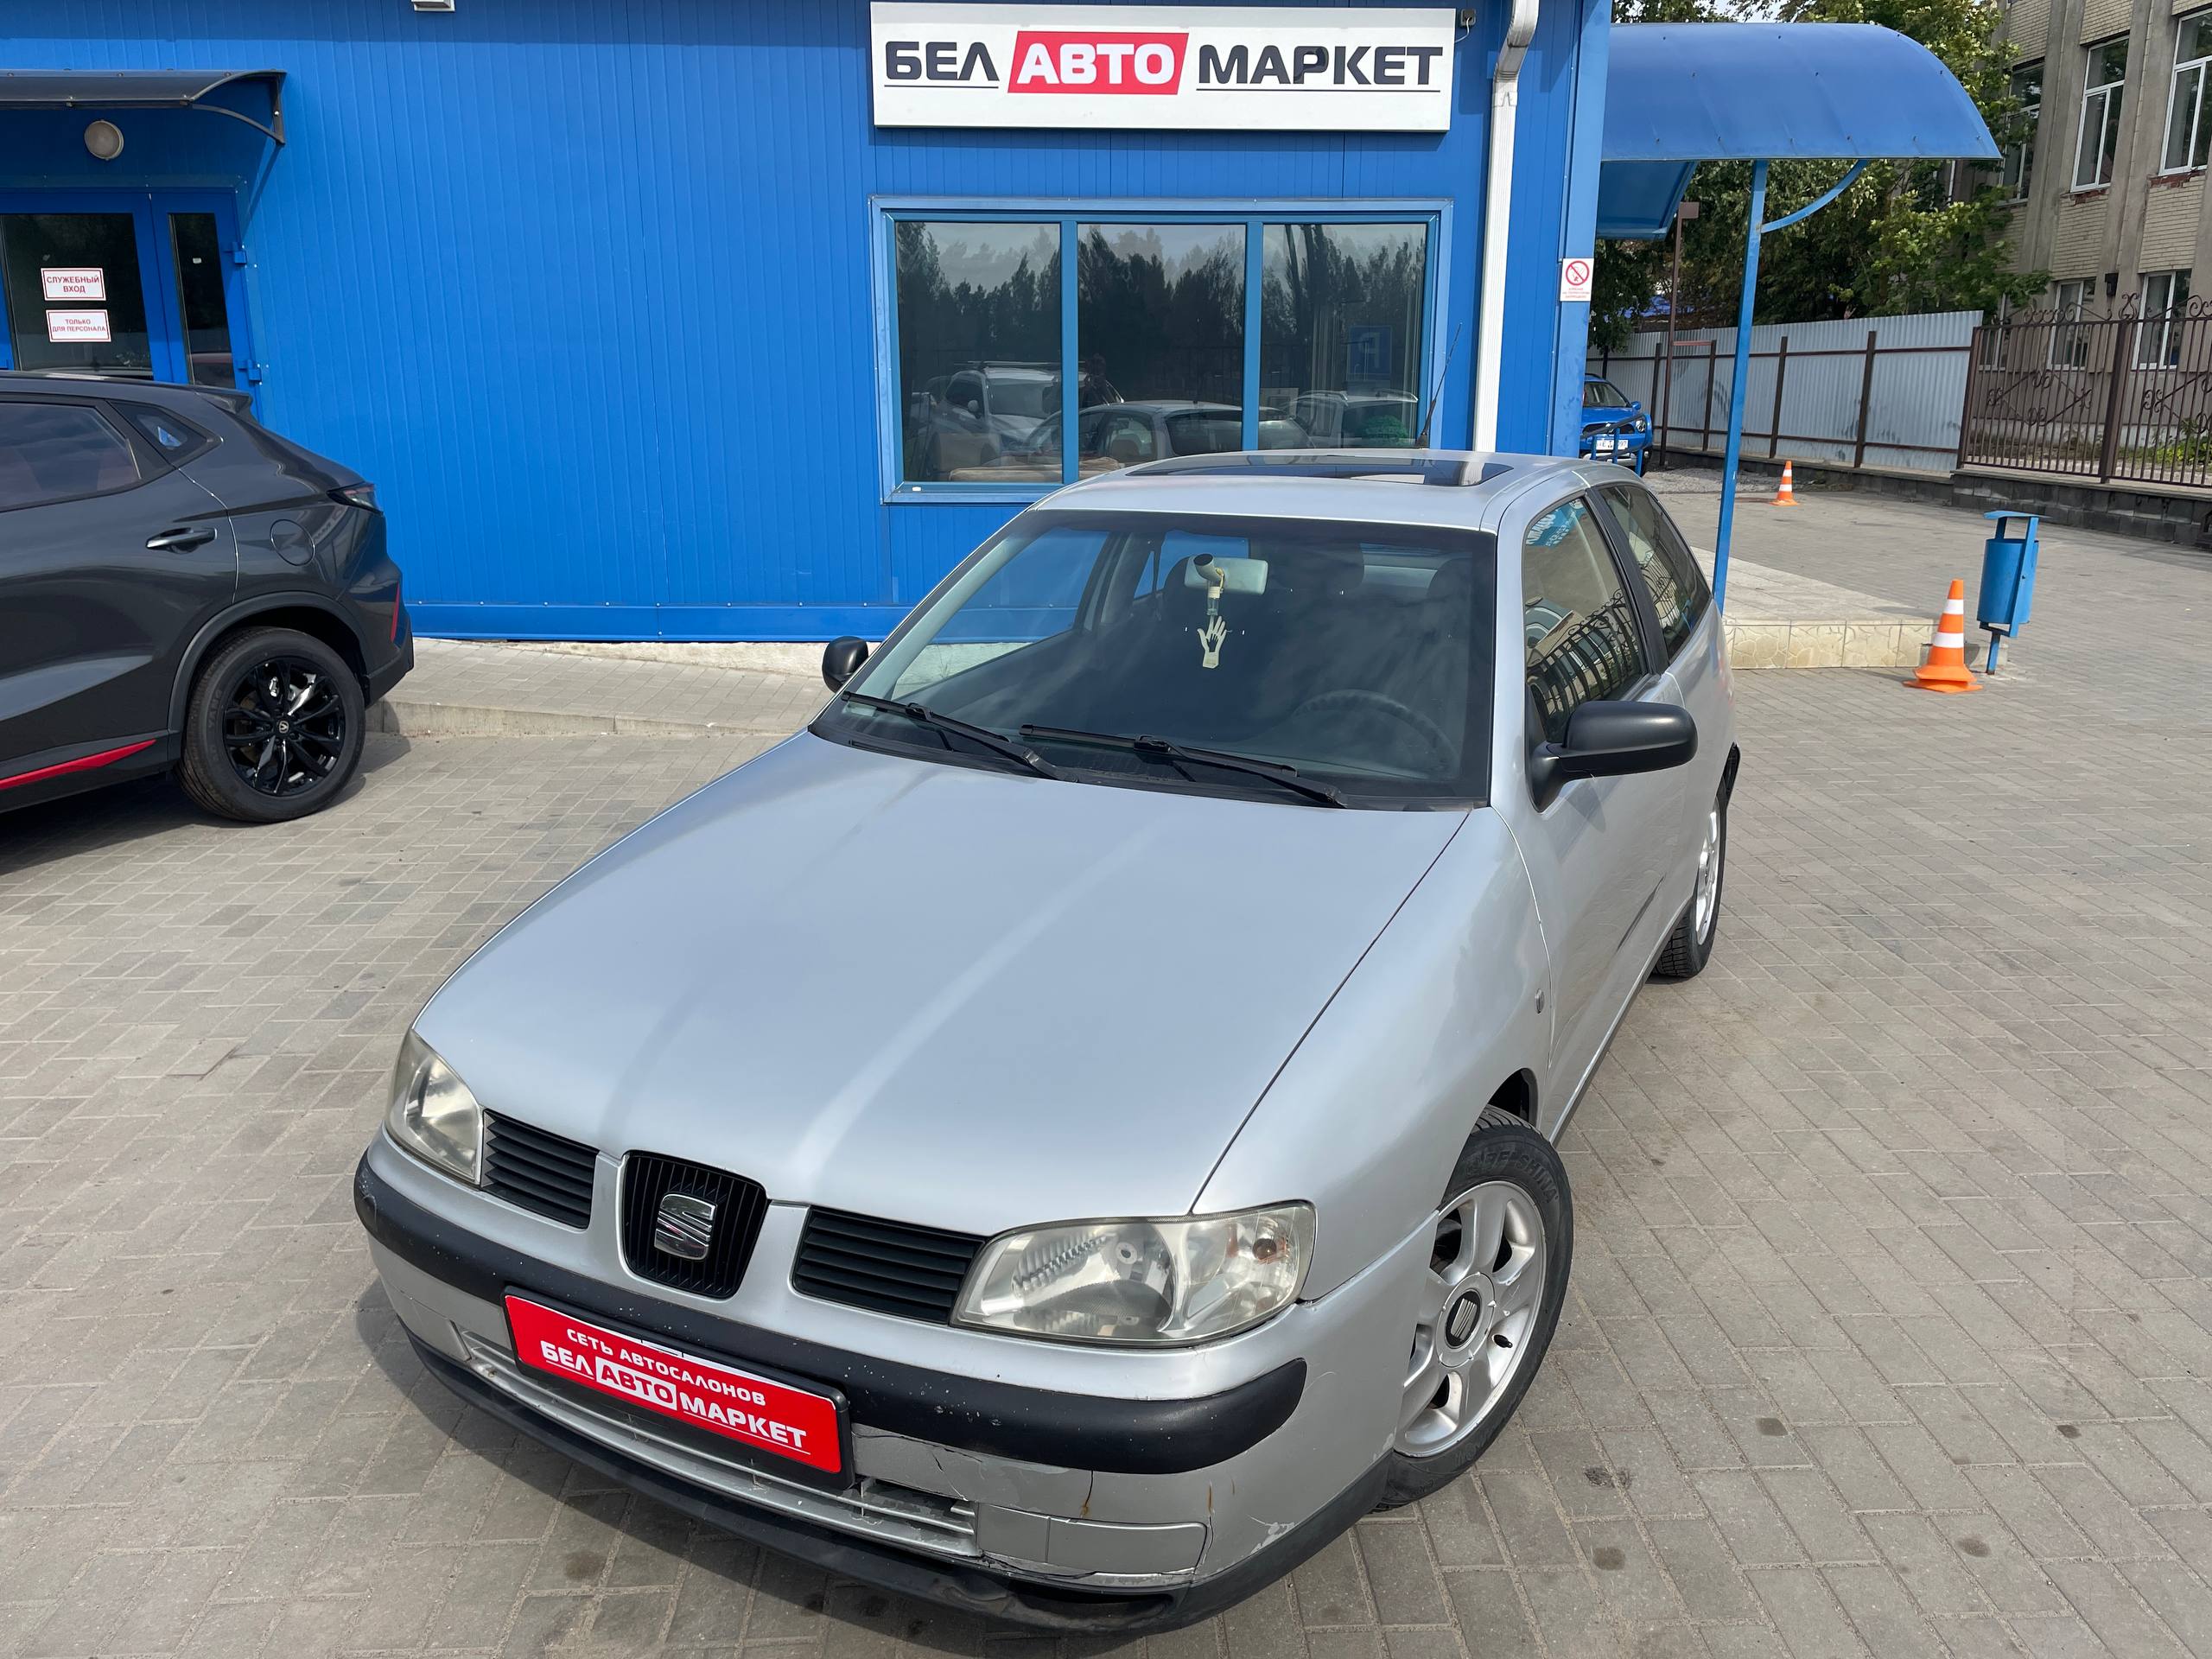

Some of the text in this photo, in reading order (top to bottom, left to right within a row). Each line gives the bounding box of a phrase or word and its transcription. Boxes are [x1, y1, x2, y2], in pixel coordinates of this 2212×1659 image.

[885, 41, 1443, 85] БЕЛ АВТО МАРКЕТ
[46, 275, 100, 284] СЛУЖЕБНЫЙ
[63, 285, 86, 294] ВХОД
[567, 1328, 766, 1407] СЕТЬ АВТОСАЛОНОВ
[540, 1340, 807, 1448] БЕЛ АВТО МАРКЕТ
